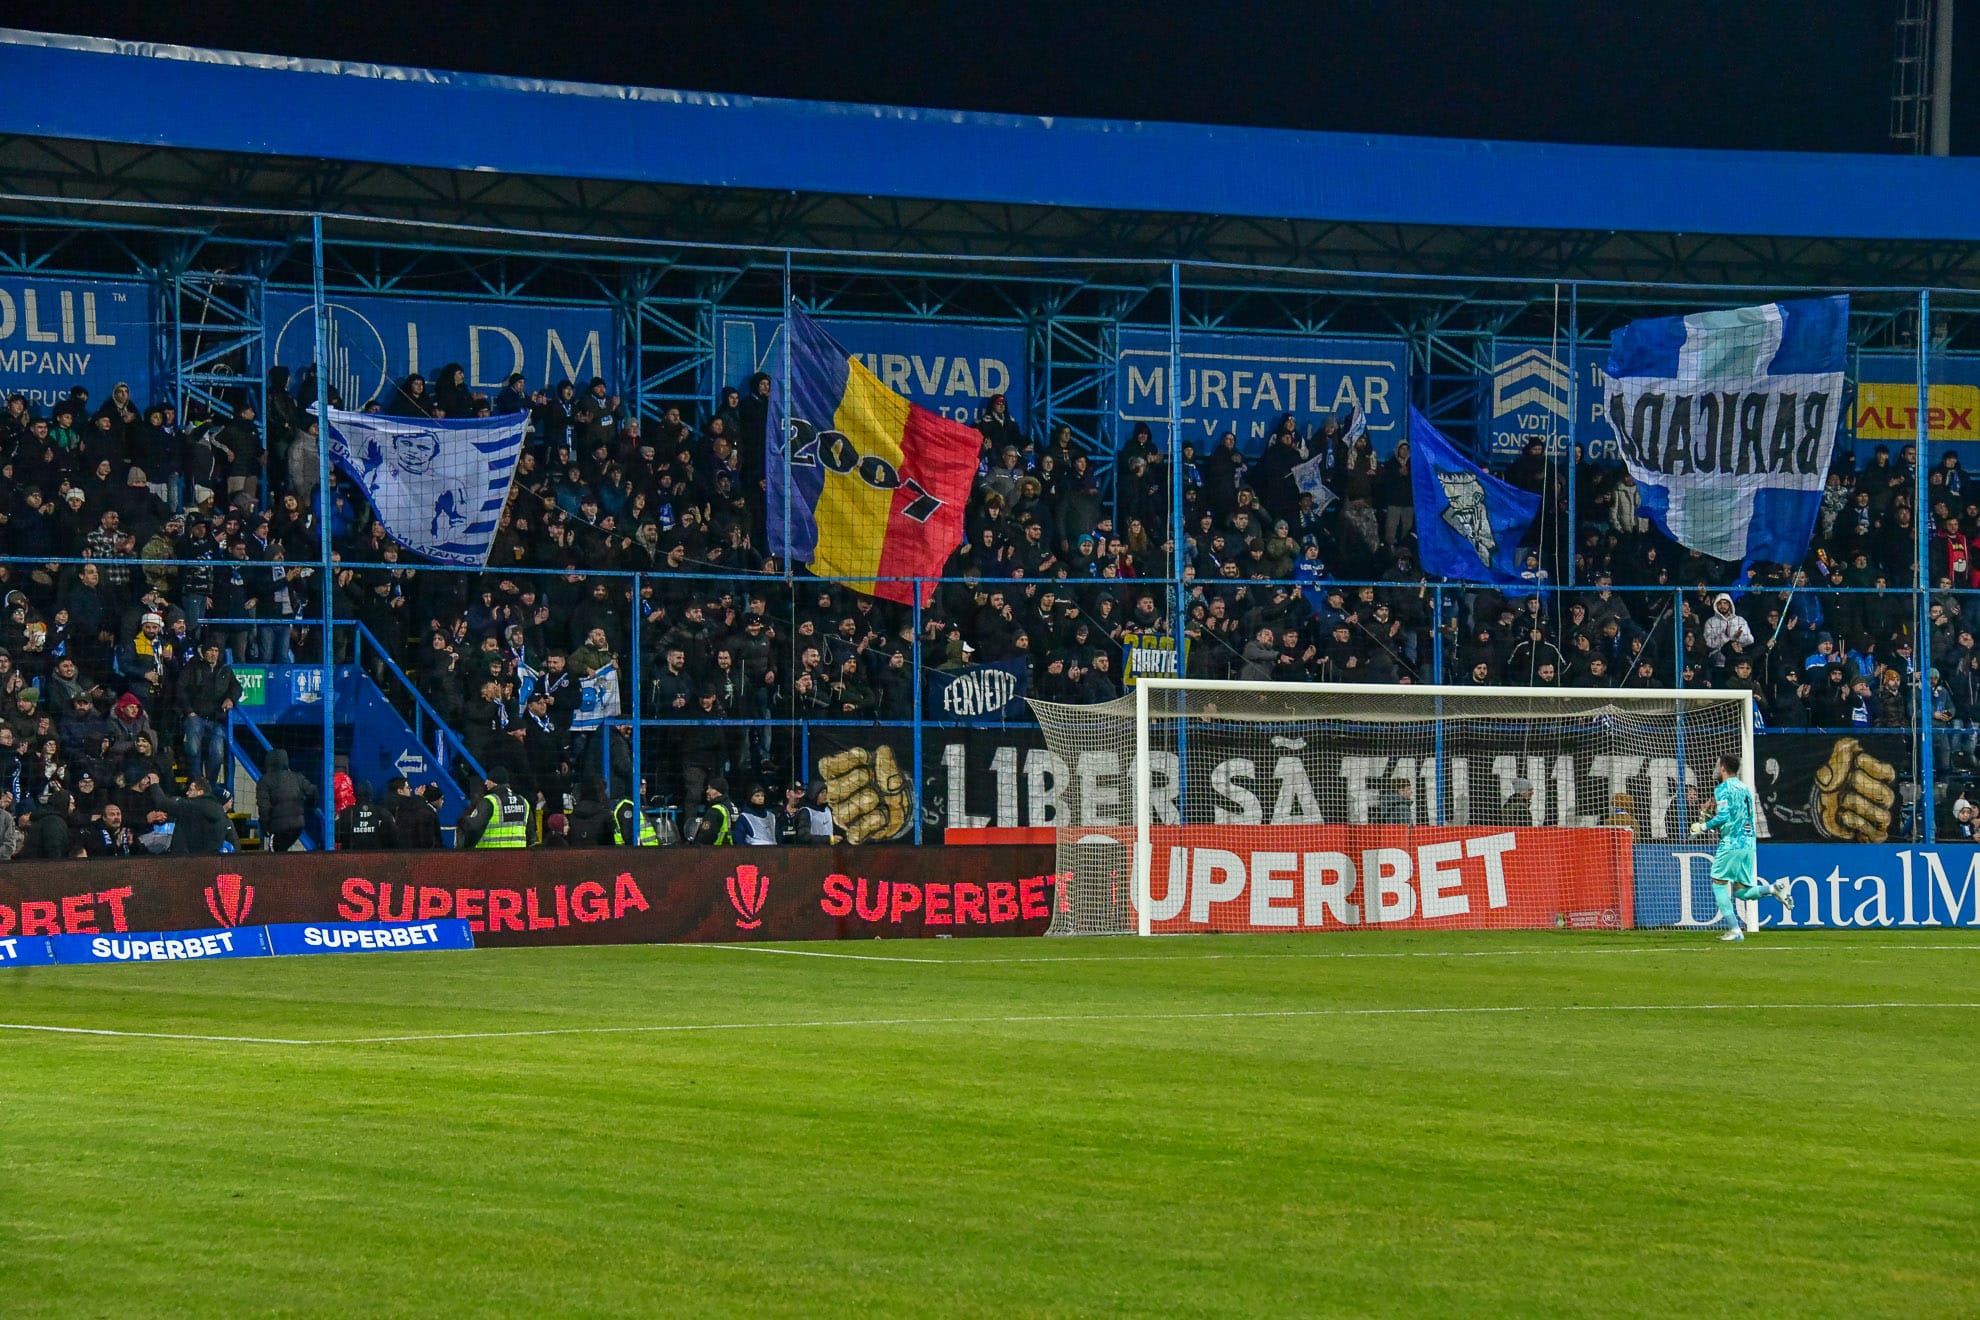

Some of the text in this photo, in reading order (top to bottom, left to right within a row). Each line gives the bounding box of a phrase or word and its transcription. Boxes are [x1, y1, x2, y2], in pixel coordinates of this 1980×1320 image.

[112, 292, 126, 302] TM
[17, 389, 72, 407] TRUS
[848, 352, 1010, 398] IRVAD
[1128, 366, 1390, 414] MURFATLAR
[1517, 414, 1549, 430] VDT
[780, 418, 948, 524] 2007
[944, 669, 1017, 715] FERVENT
[941, 744, 1181, 829] LIBER
[1492, 756, 1771, 839] ULTR
[338, 872, 650, 932] SUPERLIGA
[820, 873, 1073, 926] SUPERBET
[1077, 832, 1516, 927] UPERBET
[92, 932, 233, 960] SUPERBET
[304, 924, 440, 949] SUPERBET
